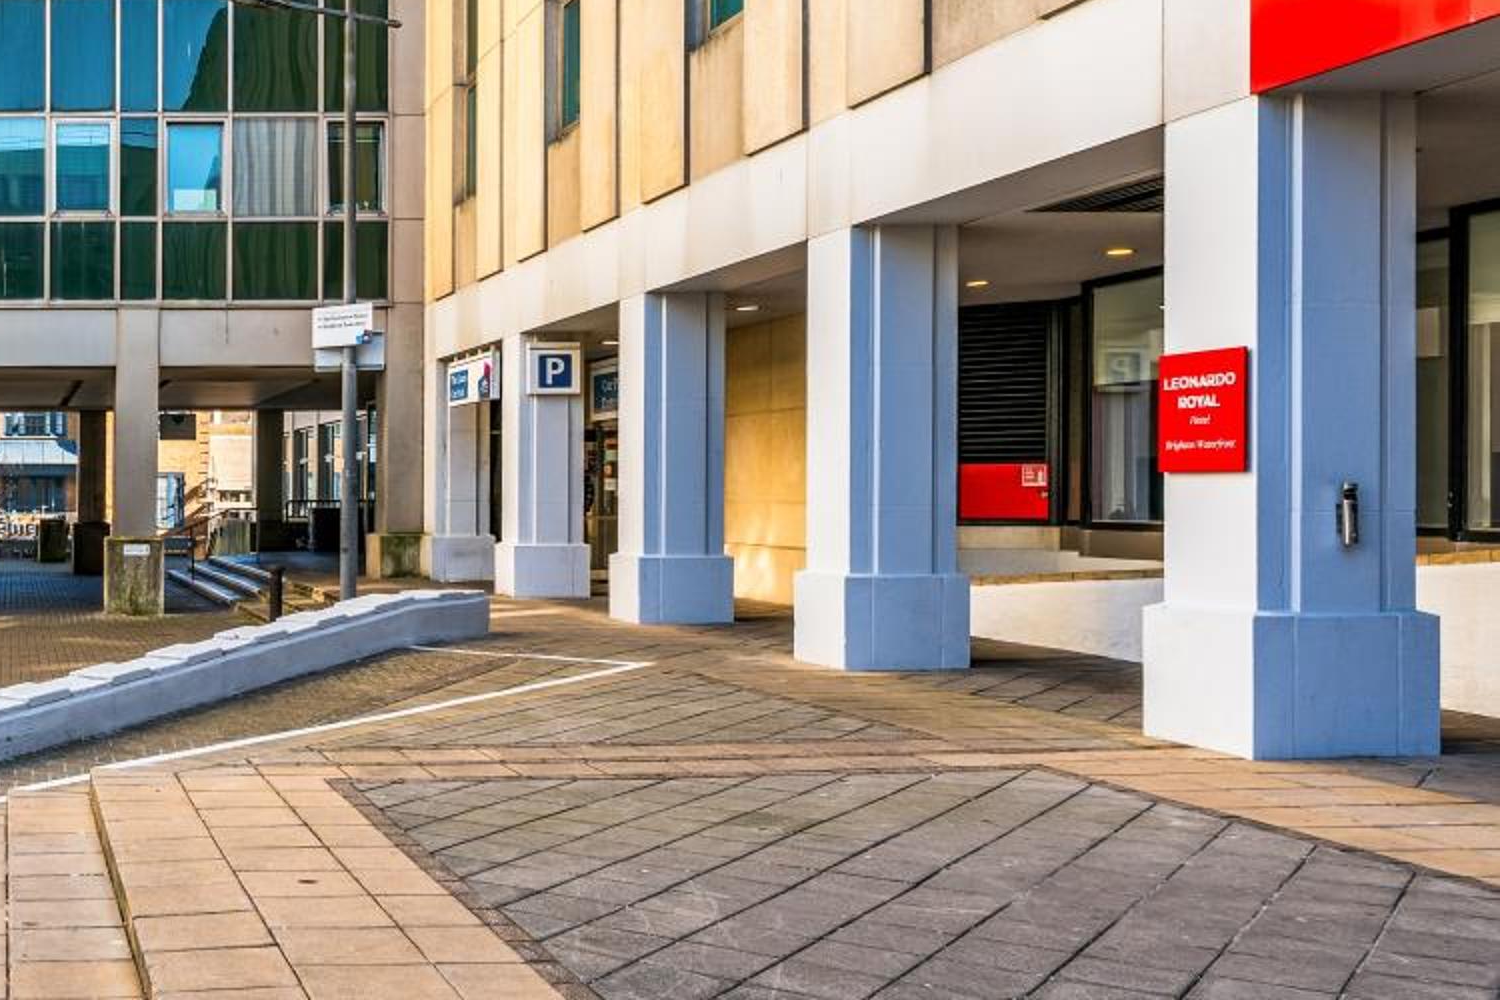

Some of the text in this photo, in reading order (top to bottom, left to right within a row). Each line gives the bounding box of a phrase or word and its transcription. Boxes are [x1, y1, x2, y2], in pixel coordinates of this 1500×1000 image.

[546, 358, 564, 385] P
[1163, 372, 1236, 391] LEONARDO
[1177, 393, 1220, 409] ROYAL
